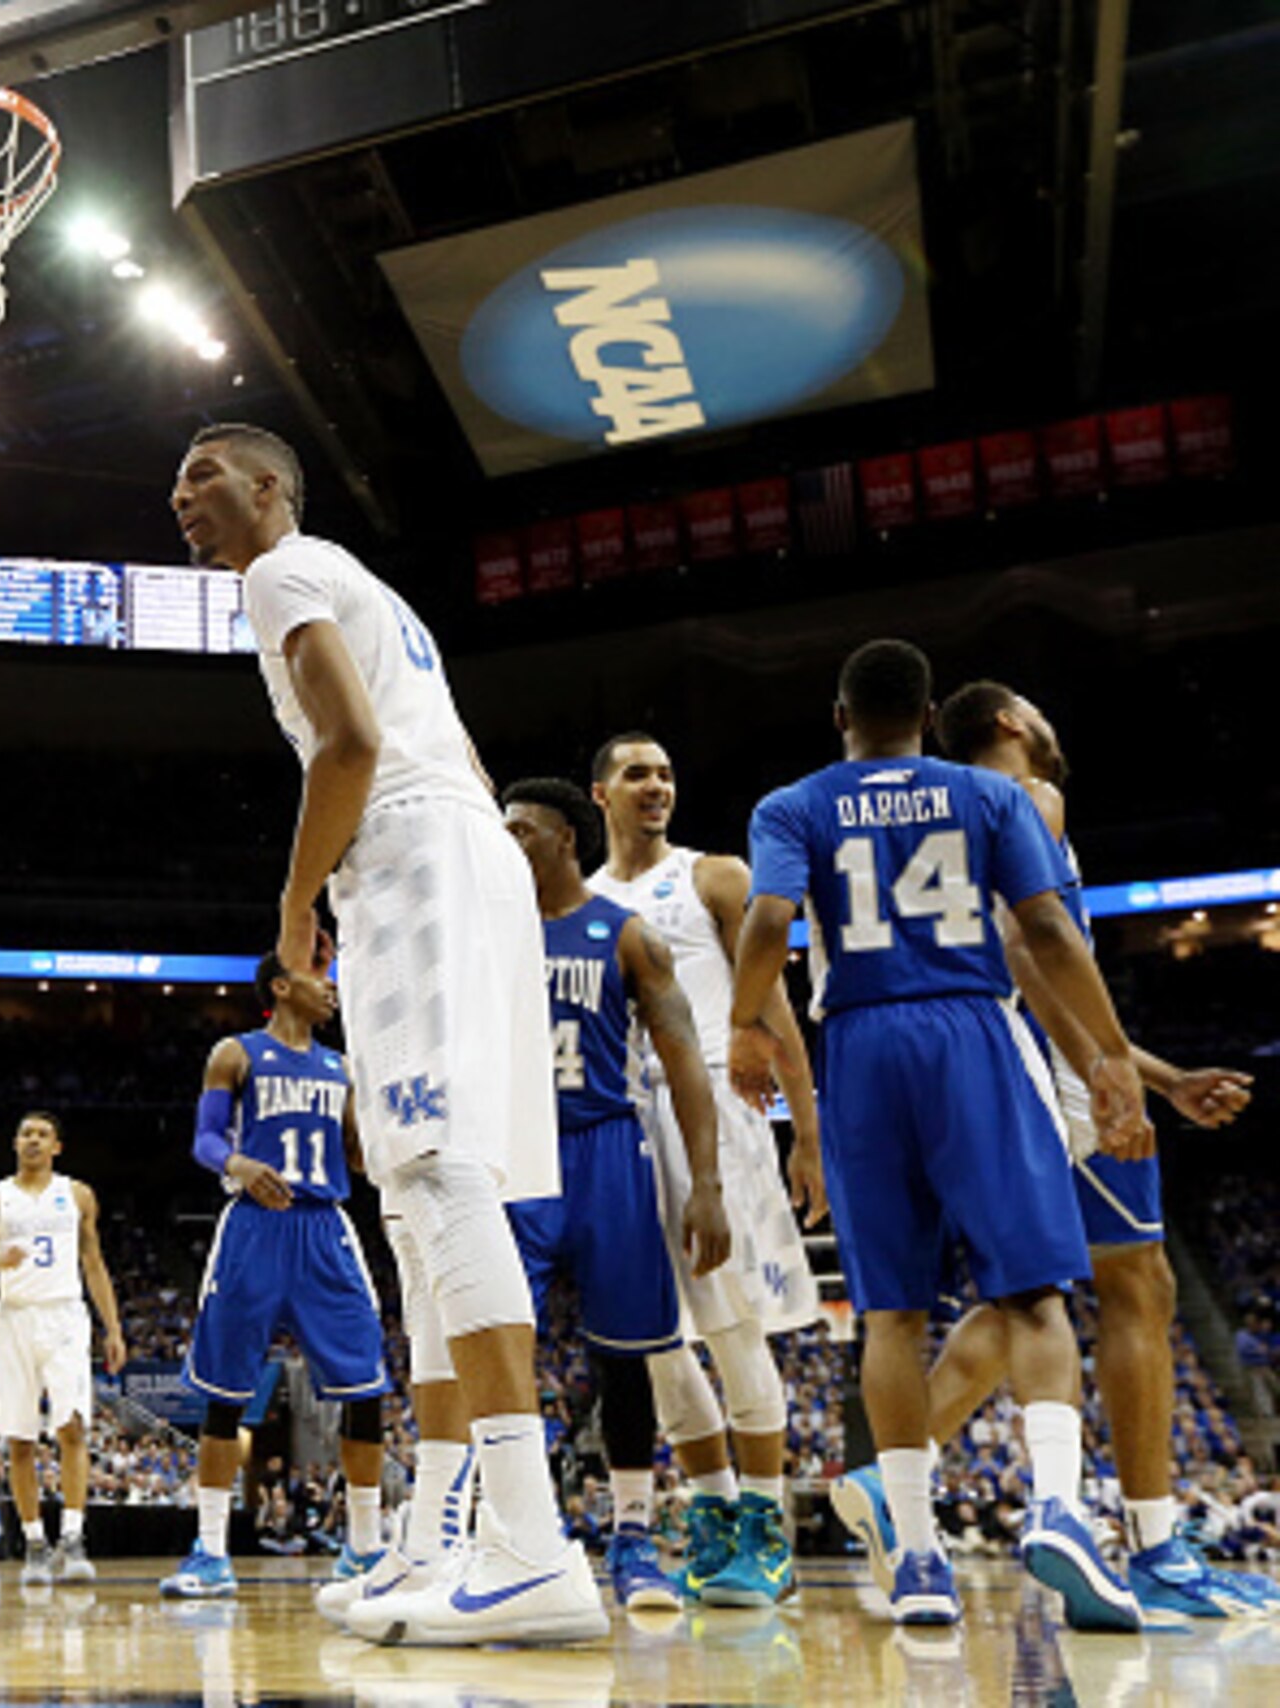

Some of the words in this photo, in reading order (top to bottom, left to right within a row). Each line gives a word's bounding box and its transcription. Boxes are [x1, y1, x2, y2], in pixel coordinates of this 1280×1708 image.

[540, 258, 706, 446] NCAA
[834, 829, 985, 952] 14
[280, 1129, 328, 1186] 11
[33, 1235, 54, 1268] 3
